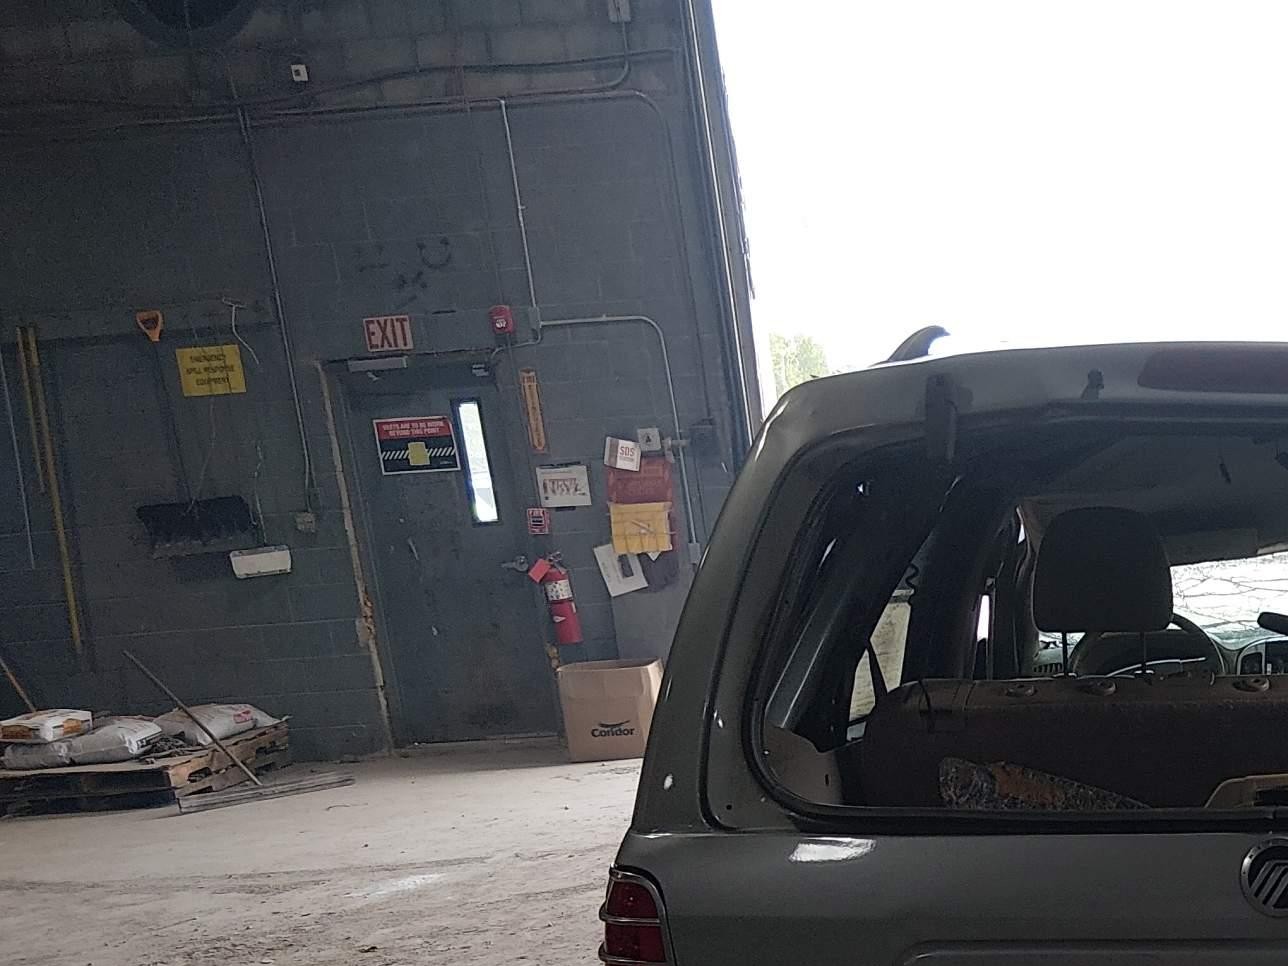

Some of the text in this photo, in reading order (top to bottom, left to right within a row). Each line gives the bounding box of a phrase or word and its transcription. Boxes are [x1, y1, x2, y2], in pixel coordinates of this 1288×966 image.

[365, 318, 409, 350] EXIT
[619, 446, 636, 457] SDS
[591, 725, 635, 738] Condor
